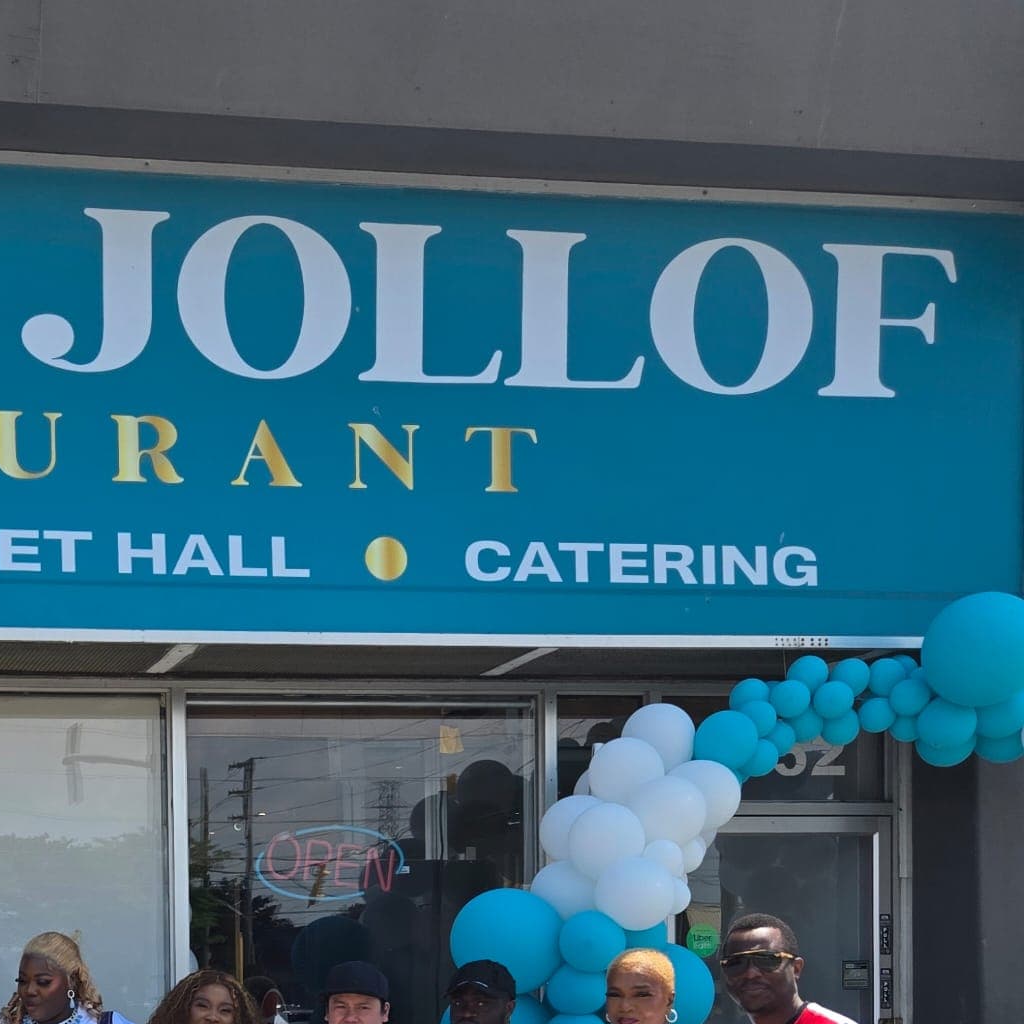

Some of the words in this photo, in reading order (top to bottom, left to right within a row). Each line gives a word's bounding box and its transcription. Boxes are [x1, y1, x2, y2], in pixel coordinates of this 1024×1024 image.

[22, 208, 957, 398] JOLLOF
[118, 532, 310, 578] HALL
[465, 540, 818, 587] CATERING
[265, 832, 396, 893] OPEN
